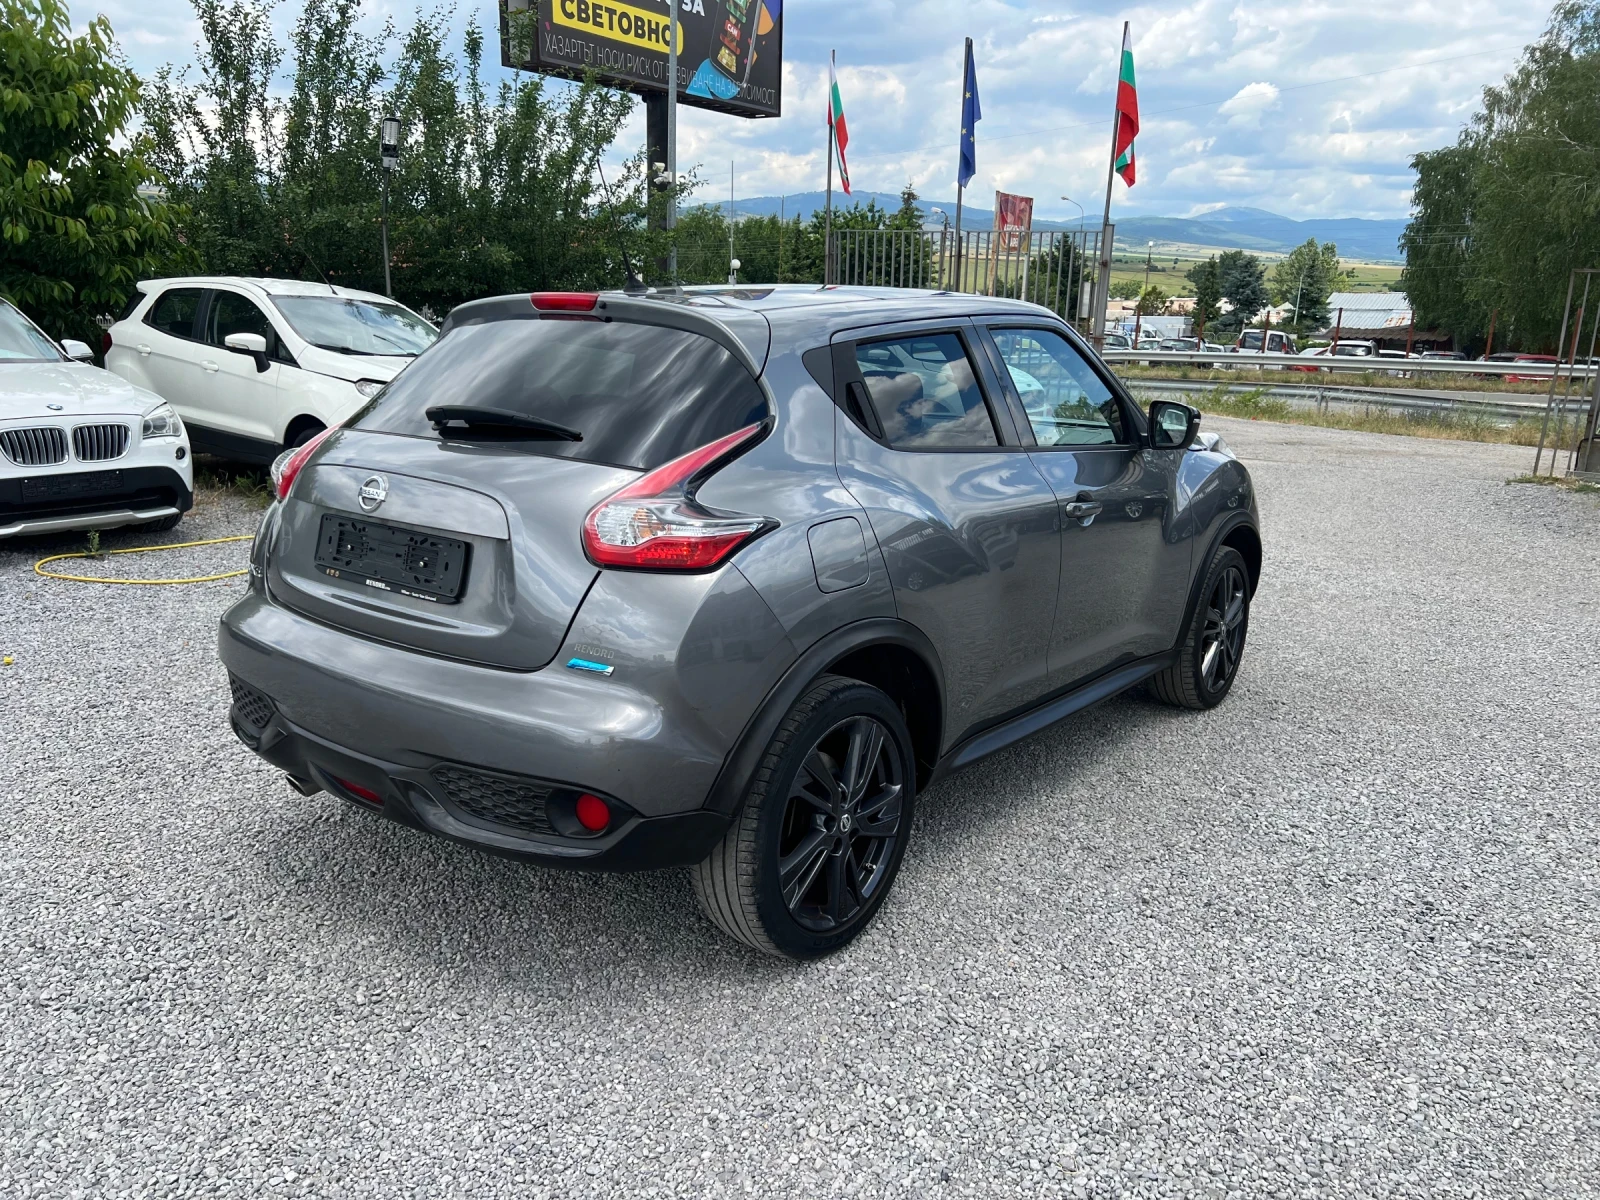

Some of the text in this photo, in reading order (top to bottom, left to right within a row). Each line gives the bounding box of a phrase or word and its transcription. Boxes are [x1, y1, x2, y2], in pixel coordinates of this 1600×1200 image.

[560, 0, 672, 47] СВЕТОВНО
[544, 32, 595, 63] ХАЗАРТЪТ
[597, 45, 625, 70] НОСИ
[627, 53, 651, 76] РИСК
[652, 60, 665, 79] ОТ
[666, 63, 714, 92] РЗВИВАНЕ
[715, 76, 727, 93] НА
[573, 643, 615, 659] RENORD
